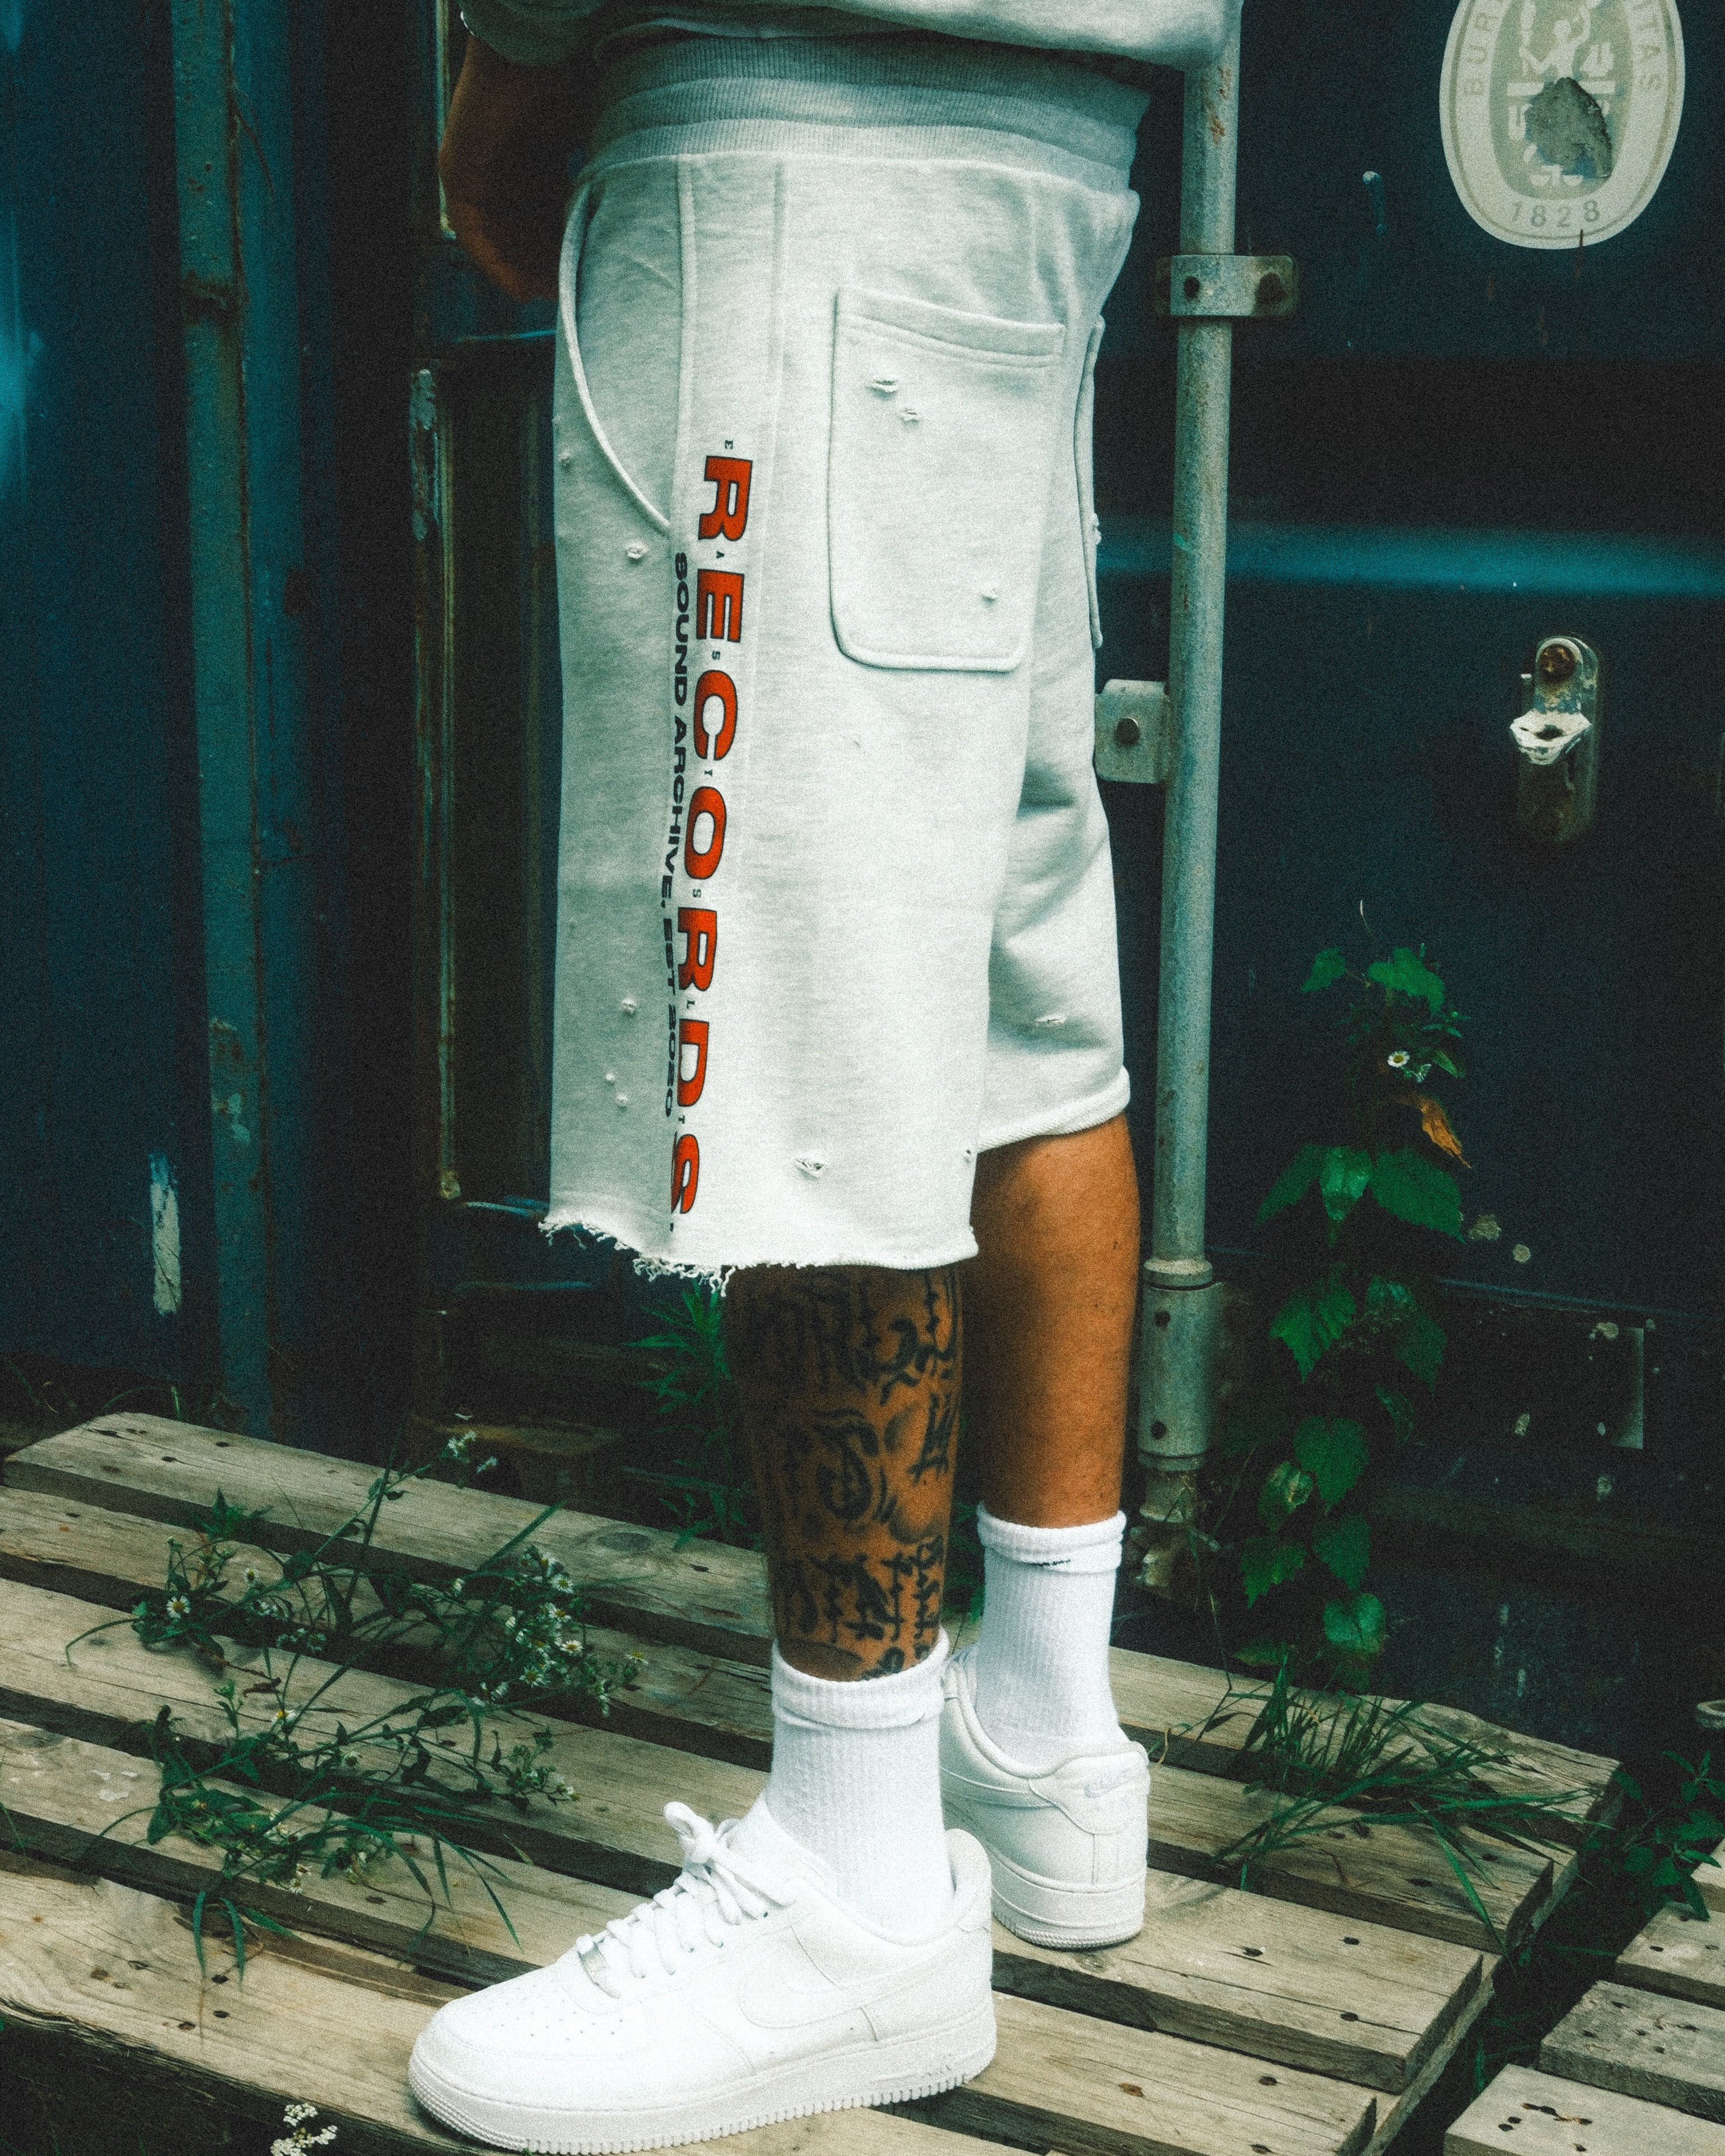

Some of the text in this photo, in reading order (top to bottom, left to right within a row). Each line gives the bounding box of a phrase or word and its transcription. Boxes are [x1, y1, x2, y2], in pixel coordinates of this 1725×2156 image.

[1463, 0, 1503, 96] BUR
[1511, 199, 1600, 228] 1828
[674, 552, 689, 707] SOUND
[671, 455, 753, 1214] RECORDS
[663, 918, 676, 996] EST
[665, 1004, 677, 1117] 2020
